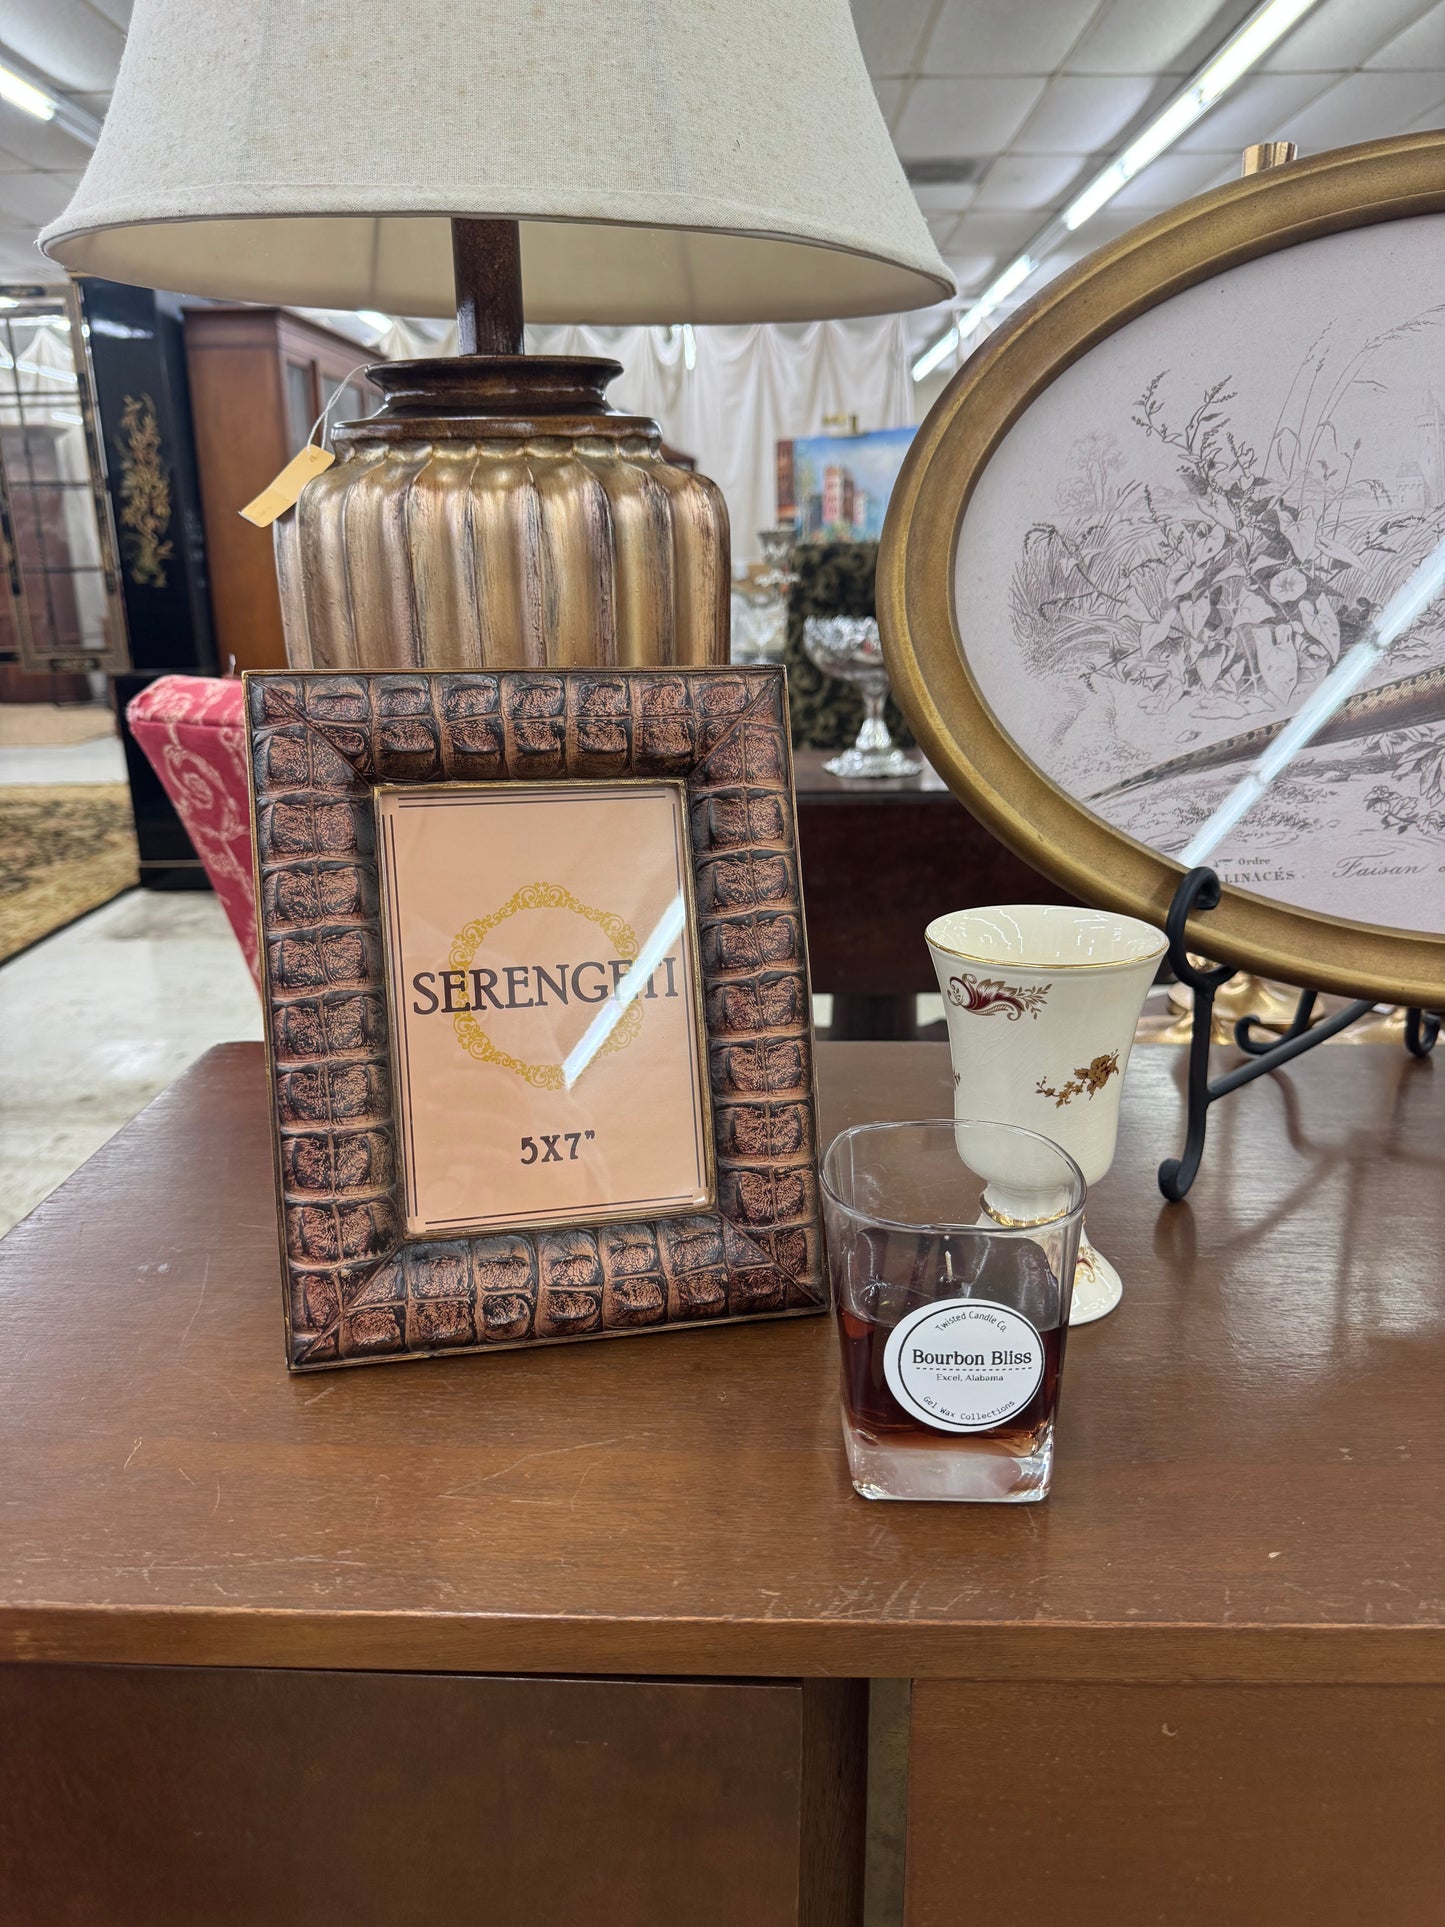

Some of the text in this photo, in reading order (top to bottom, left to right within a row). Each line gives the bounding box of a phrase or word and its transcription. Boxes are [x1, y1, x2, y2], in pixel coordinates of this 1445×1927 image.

[1238, 857, 1271, 866] Ordre
[1332, 850, 1430, 878] Faisan
[935, 1310, 1007, 1333] Twisted Candle Co.
[912, 1349, 1032, 1366] Bourbon Bliss
[936, 1373, 1004, 1382] Excel, Alabama
[923, 1396, 1016, 1421] Gel Wax Collections
